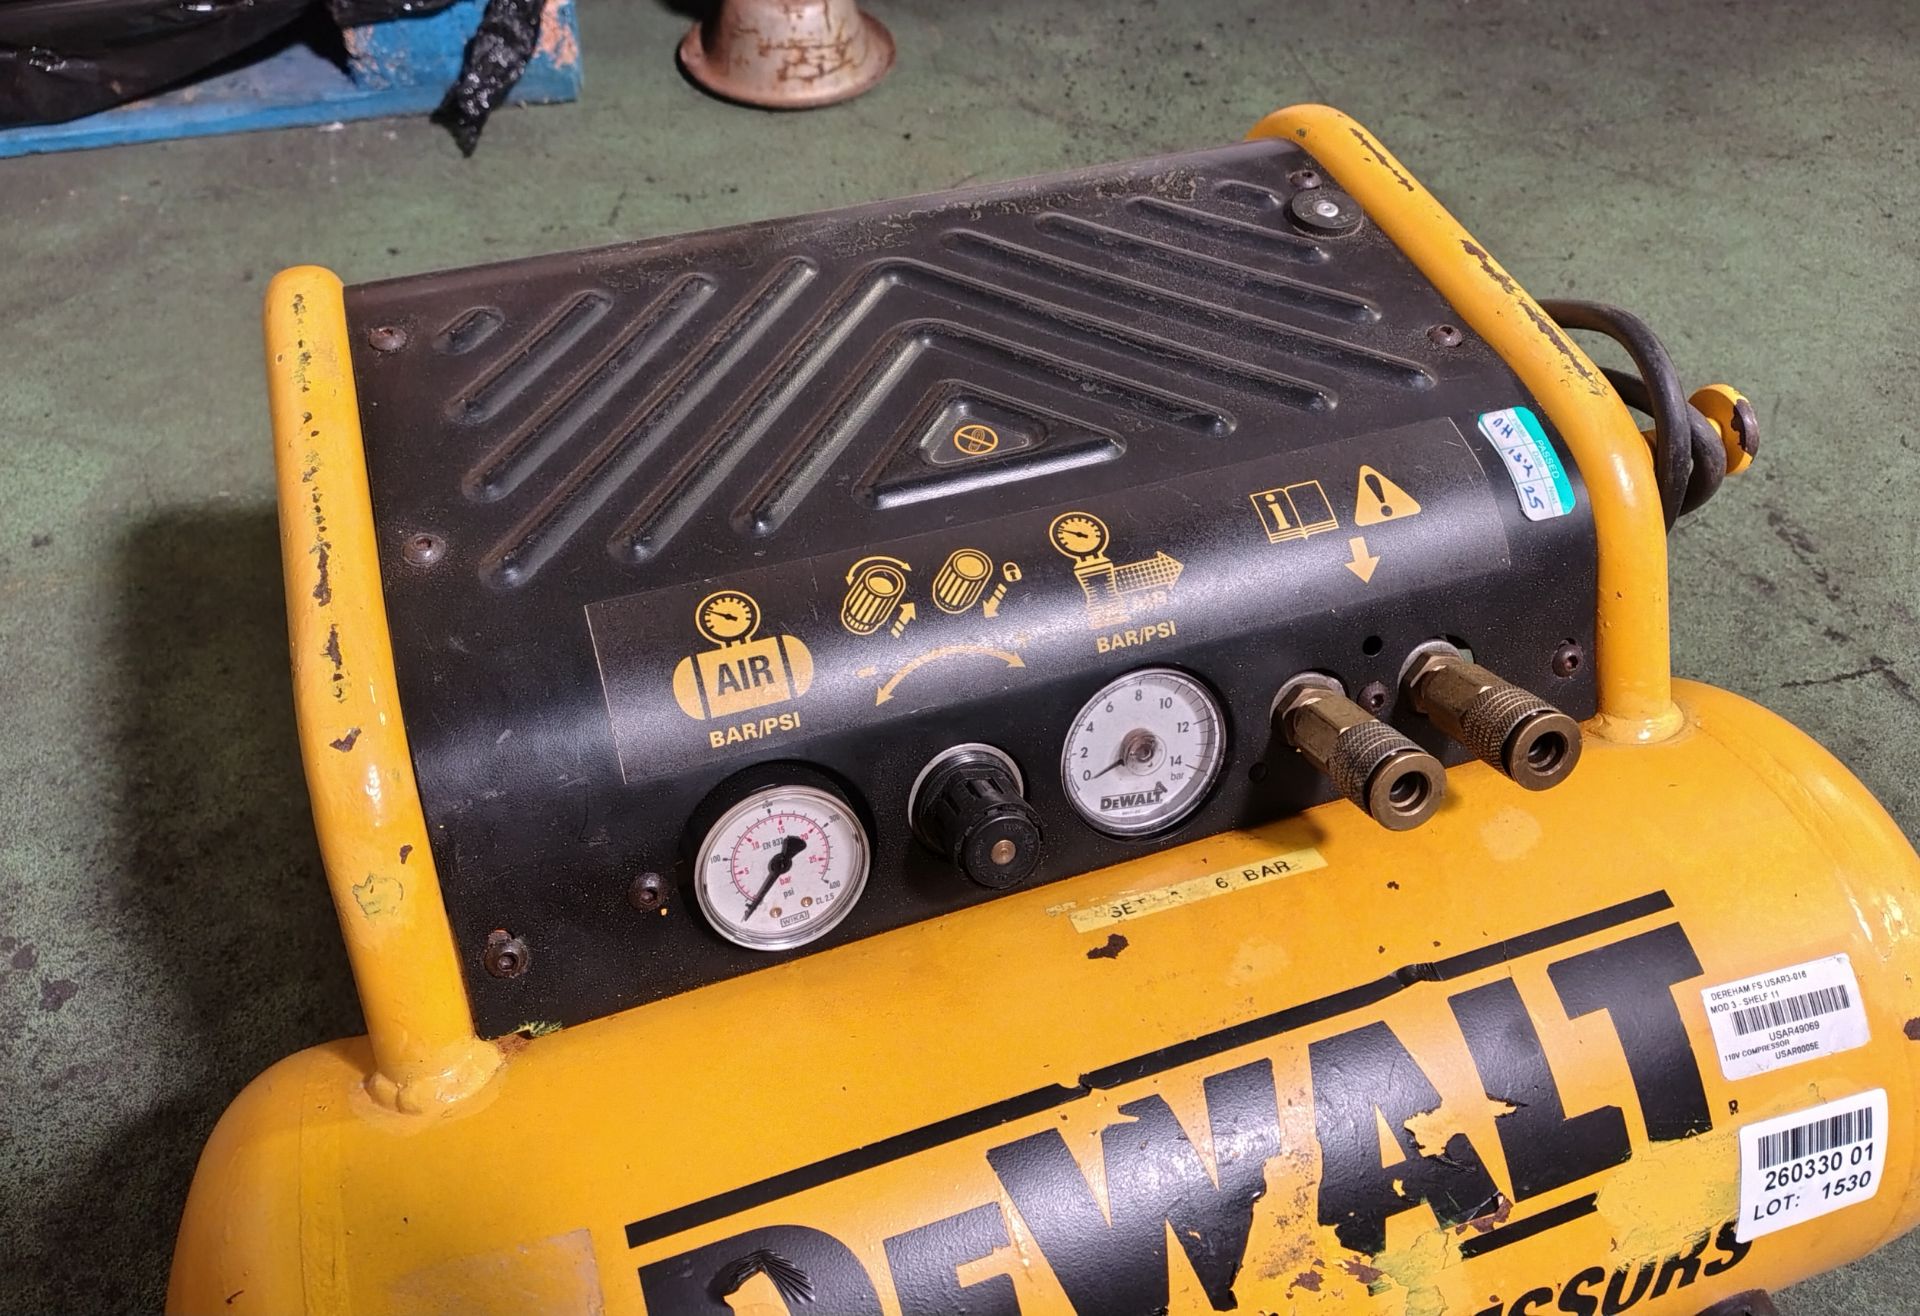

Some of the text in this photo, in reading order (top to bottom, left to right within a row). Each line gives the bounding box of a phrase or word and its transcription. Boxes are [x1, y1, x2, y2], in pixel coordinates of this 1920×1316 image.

[1536, 439, 1560, 479] PASSED
[1523, 486, 1544, 509] 25
[1096, 620, 1177, 653] BAR/PSI
[717, 655, 775, 696] AIR
[1135, 689, 1142, 701] 8
[1105, 702, 1114, 713] 6
[1159, 697, 1173, 709] 10
[709, 711, 801, 748] BAR/PSI
[1086, 722, 1094, 732] 4
[1177, 721, 1189, 733] 12
[1080, 747, 1088, 758] 2
[1170, 755, 1182, 766] 14
[1082, 770, 1091, 781] 0
[1170, 771, 1184, 781] bar
[777, 826, 785, 834] 15
[800, 833, 809, 841] 20
[751, 841, 760, 850] 10
[762, 841, 771, 850] EN
[711, 854, 721, 864] 100
[808, 855, 817, 864] 25
[744, 867, 750, 875] 5
[1215, 877, 1229, 889] 6
[1242, 860, 1291, 882] BAR
[779, 875, 792, 886] bar
[829, 880, 841, 890] 400
[783, 888, 795, 899] psi
[815, 892, 835, 905] CL 2.5
[1710, 984, 1750, 1001] DEREHAM
[1752, 982, 1763, 990] FS
[1710, 1003, 1730, 1015] MOD
[1732, 1000, 1737, 1008] 3
[1743, 992, 1769, 1006] SHELF
[1770, 990, 1780, 998] 11
[1769, 1020, 1820, 1041] USAR49069
[1724, 1039, 1790, 1062] 110V COMPRESSOR
[1775, 1041, 1820, 1060] USAR0005E
[1764, 1142, 1873, 1191] 260330 01
[1753, 1170, 1872, 1221] LOT: 1530
